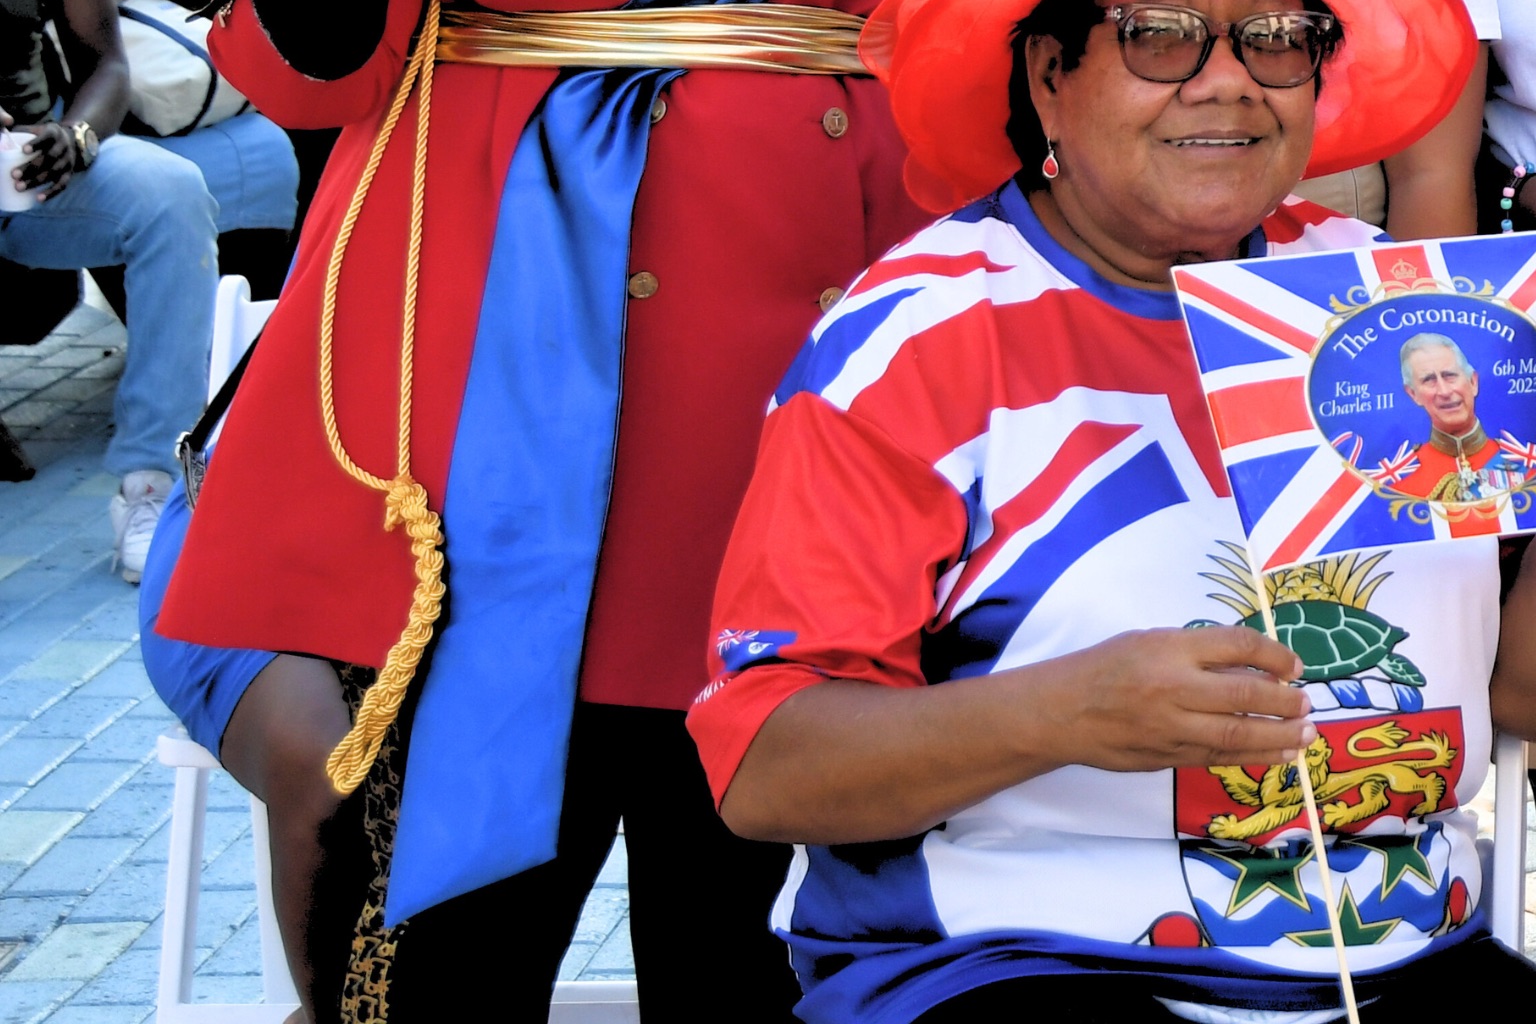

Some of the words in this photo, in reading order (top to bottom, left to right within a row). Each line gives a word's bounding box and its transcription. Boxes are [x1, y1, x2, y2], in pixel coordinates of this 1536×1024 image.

[1332, 326, 1379, 360] The
[1379, 307, 1516, 343] Coronation
[1492, 358, 1516, 377] 6th
[1334, 380, 1371, 399] King
[1318, 397, 1372, 417] Charles
[1376, 392, 1395, 410] III
